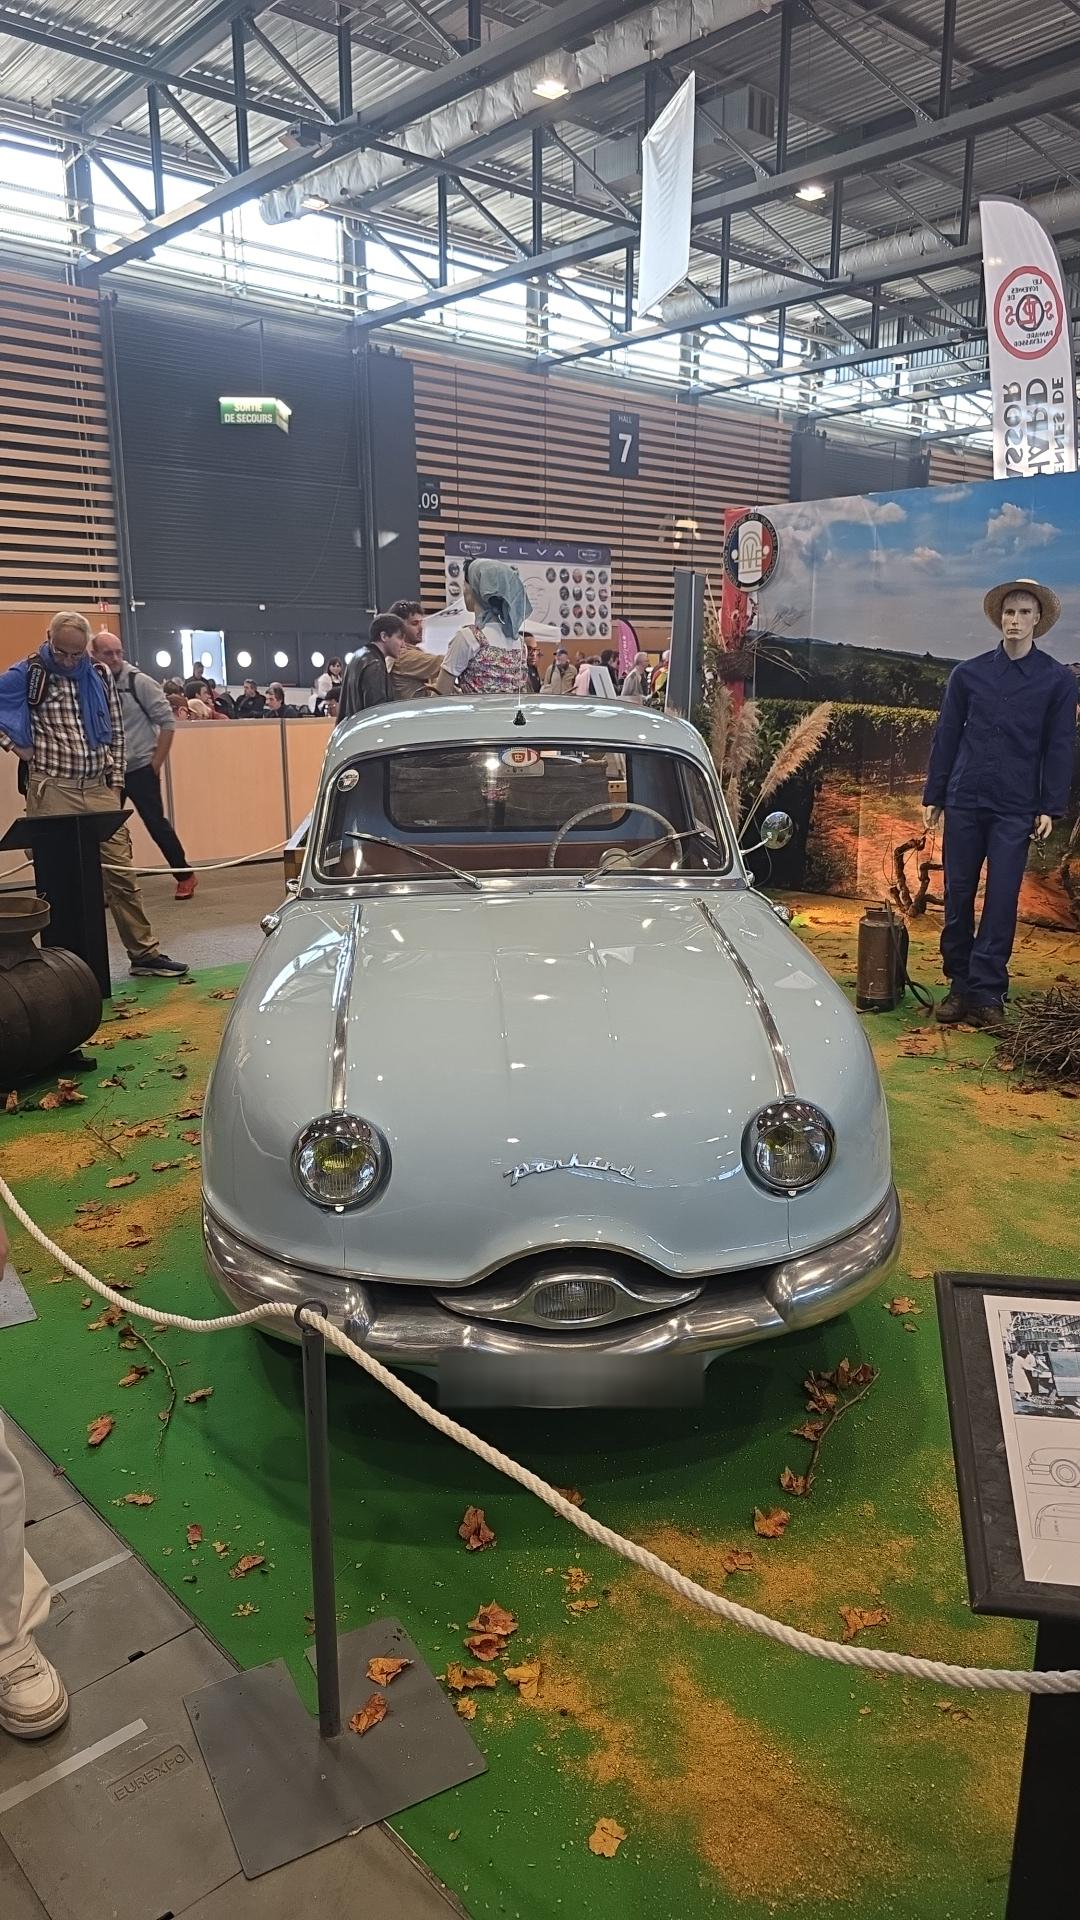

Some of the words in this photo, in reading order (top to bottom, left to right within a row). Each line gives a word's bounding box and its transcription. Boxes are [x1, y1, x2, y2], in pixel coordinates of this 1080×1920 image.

[233, 401, 263, 412] SORTIE
[224, 413, 236, 423] DE
[236, 413, 273, 423] SECOURS
[618, 415, 633, 424] HALL
[618, 433, 632, 463] 7
[113, 1753, 186, 1801] EUREXPO
